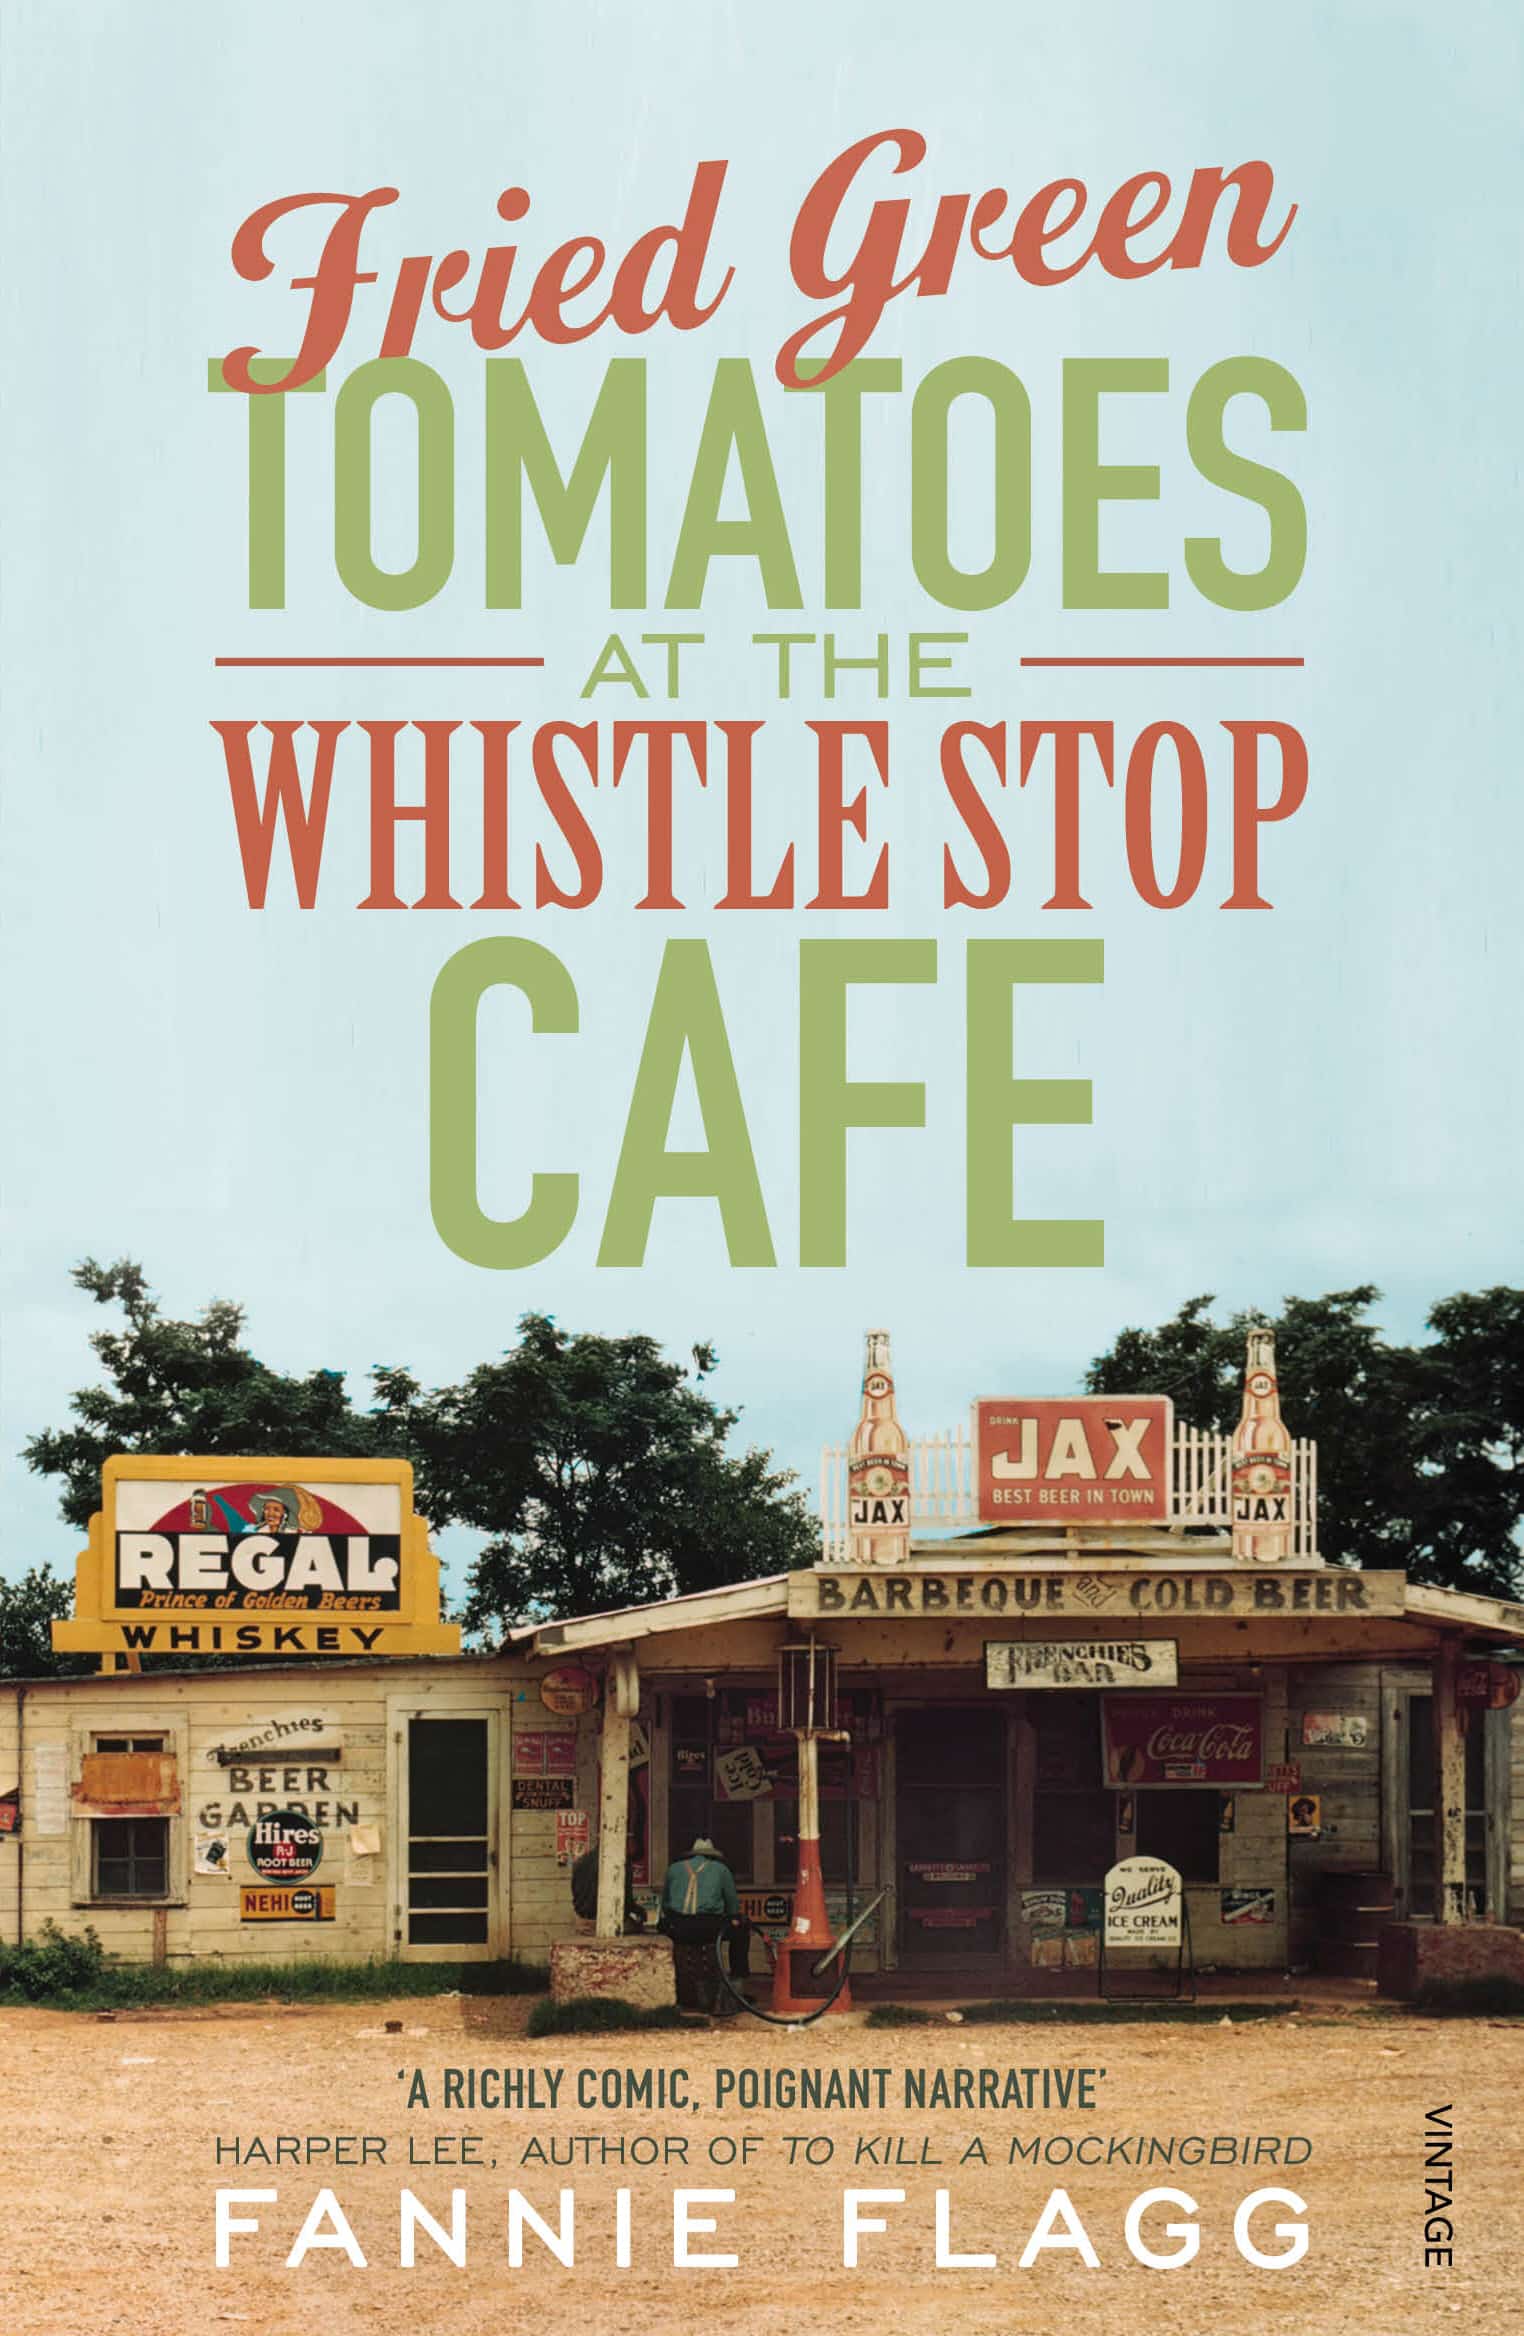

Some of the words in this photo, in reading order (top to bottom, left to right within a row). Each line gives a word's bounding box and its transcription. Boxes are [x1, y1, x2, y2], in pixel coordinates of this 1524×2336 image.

[991, 1418, 1153, 1480] JAX
[992, 1488, 1032, 1504] BEST
[1039, 1488, 1080, 1504] BEER
[1087, 1488, 1103, 1504] IN
[1111, 1489, 1154, 1504] TOWN
[854, 1499, 904, 1524] JAX
[1237, 1497, 1286, 1521] JAX
[119, 1534, 399, 1592] REGAL
[139, 1590, 208, 1609] Prince
[214, 1591, 238, 1610] of
[243, 1591, 308, 1610] Golden
[318, 1592, 382, 1610] Beers
[817, 1577, 1065, 1611] BARBEQUE
[1129, 1577, 1234, 1610] COLD
[1253, 1577, 1370, 1610] BEER
[121, 1625, 385, 1650] WHISKEY
[229, 1767, 331, 1793] BEER
[518, 1781, 568, 1792] DENTAL
[522, 1799, 561, 1809] SNUFF
[560, 1812, 587, 1827] TOP
[254, 1822, 320, 1844] Hires
[257, 1858, 287, 1868] ROOT
[289, 1858, 313, 1868] BEER
[245, 1894, 289, 1912] NEHI
[1109, 1874, 1177, 1913] Quality
[1107, 1915, 1129, 1928] ICE
[1133, 1915, 1178, 1928] CREAM
